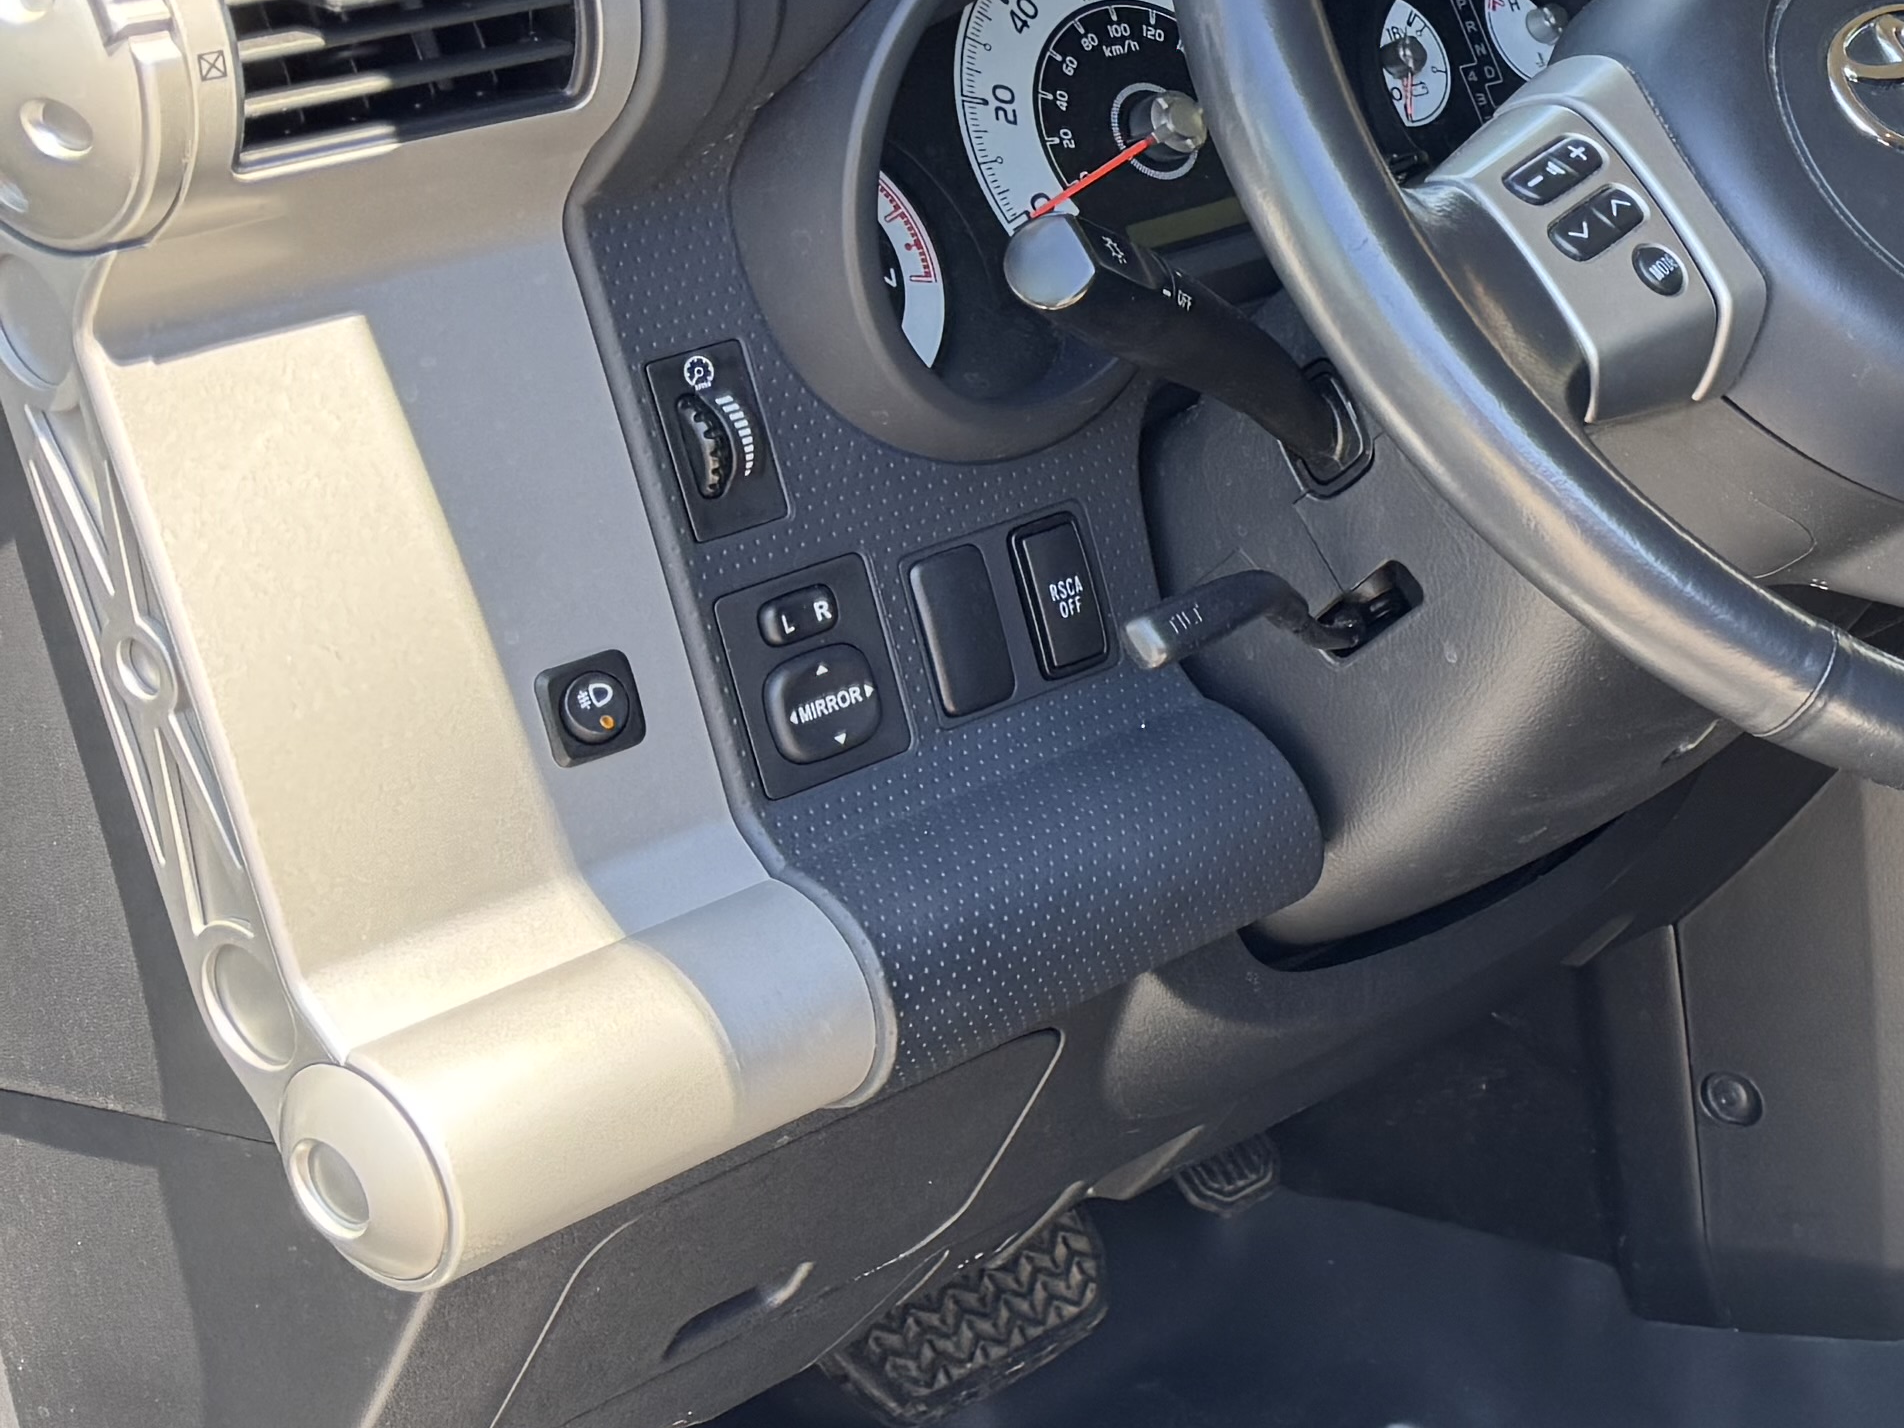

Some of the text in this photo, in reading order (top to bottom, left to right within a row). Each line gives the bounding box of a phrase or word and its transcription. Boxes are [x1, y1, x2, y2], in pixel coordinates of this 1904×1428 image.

[1107, 23, 1130, 38] 100
[1143, 24, 1165, 42] 120
[1081, 33, 1099, 52] 80
[1103, 39, 1140, 57] km/h
[1466, 20, 1480, 33] R
[1474, 43, 1488, 56] N
[1484, 67, 1495, 79] D
[1062, 56, 1078, 76] 60
[991, 84, 1018, 126] 20
[1056, 90, 1069, 112] 40
[1059, 128, 1076, 149] 20
[1648, 253, 1679, 281] MODE
[1049, 575, 1083, 601] RSCA
[813, 600, 832, 622] R
[1059, 596, 1082, 618] OFF
[781, 614, 795, 634] L
[797, 686, 863, 724] MIRROR
